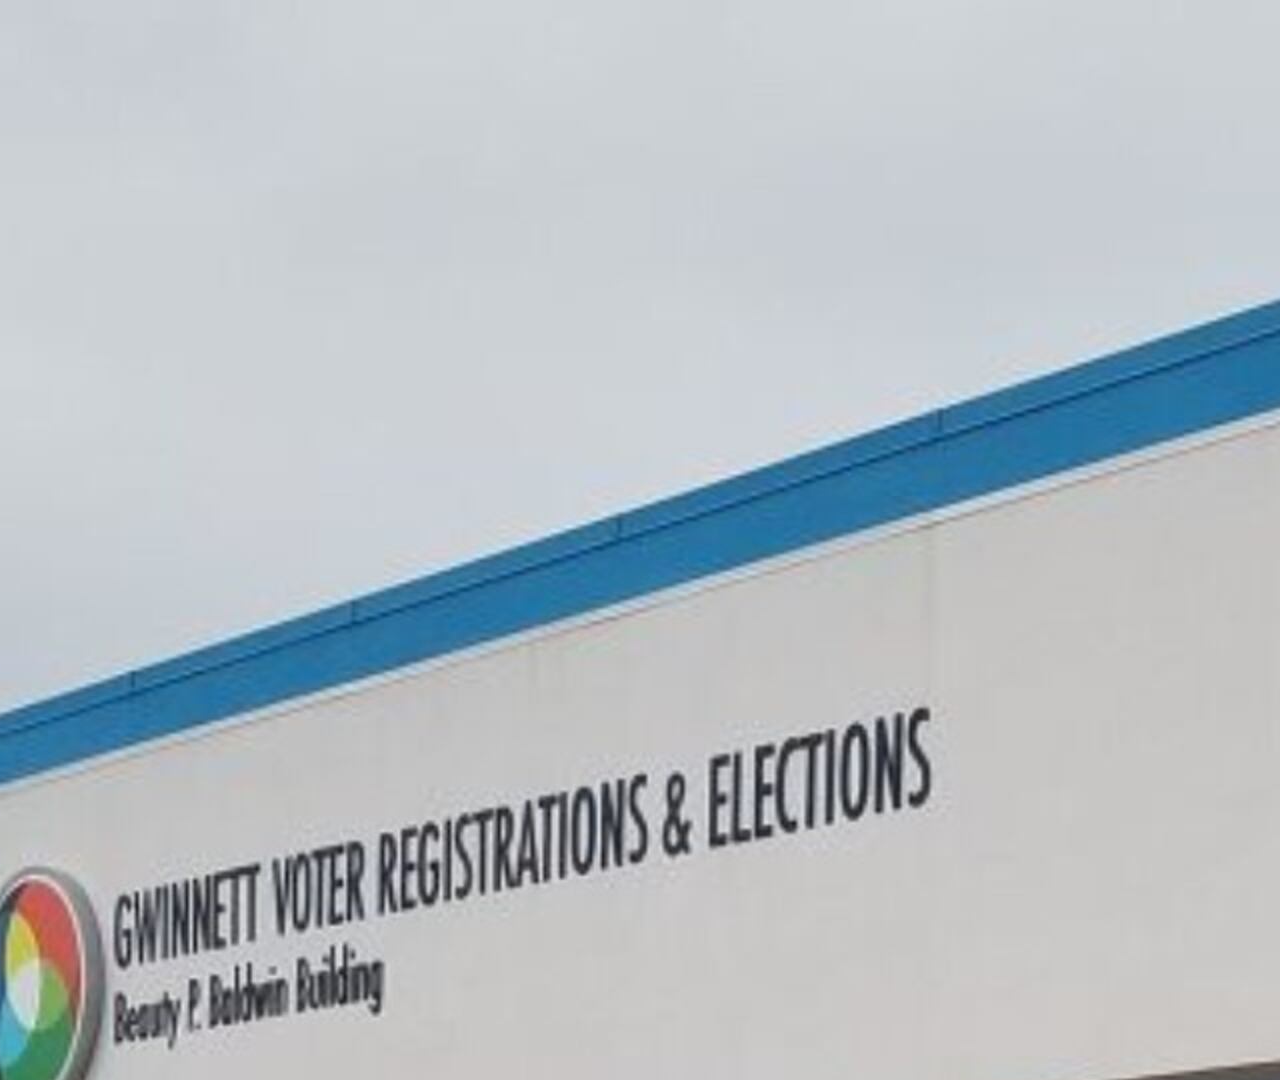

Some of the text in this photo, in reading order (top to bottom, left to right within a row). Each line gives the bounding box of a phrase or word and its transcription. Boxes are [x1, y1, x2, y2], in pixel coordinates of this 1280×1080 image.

[113, 706, 933, 970] GWINNETT VOTER REGISTRATIONS & ELECTIONS
[113, 991, 181, 1049] Beauty
[208, 961, 290, 1029] Baldwin
[295, 942, 384, 1016] Building
